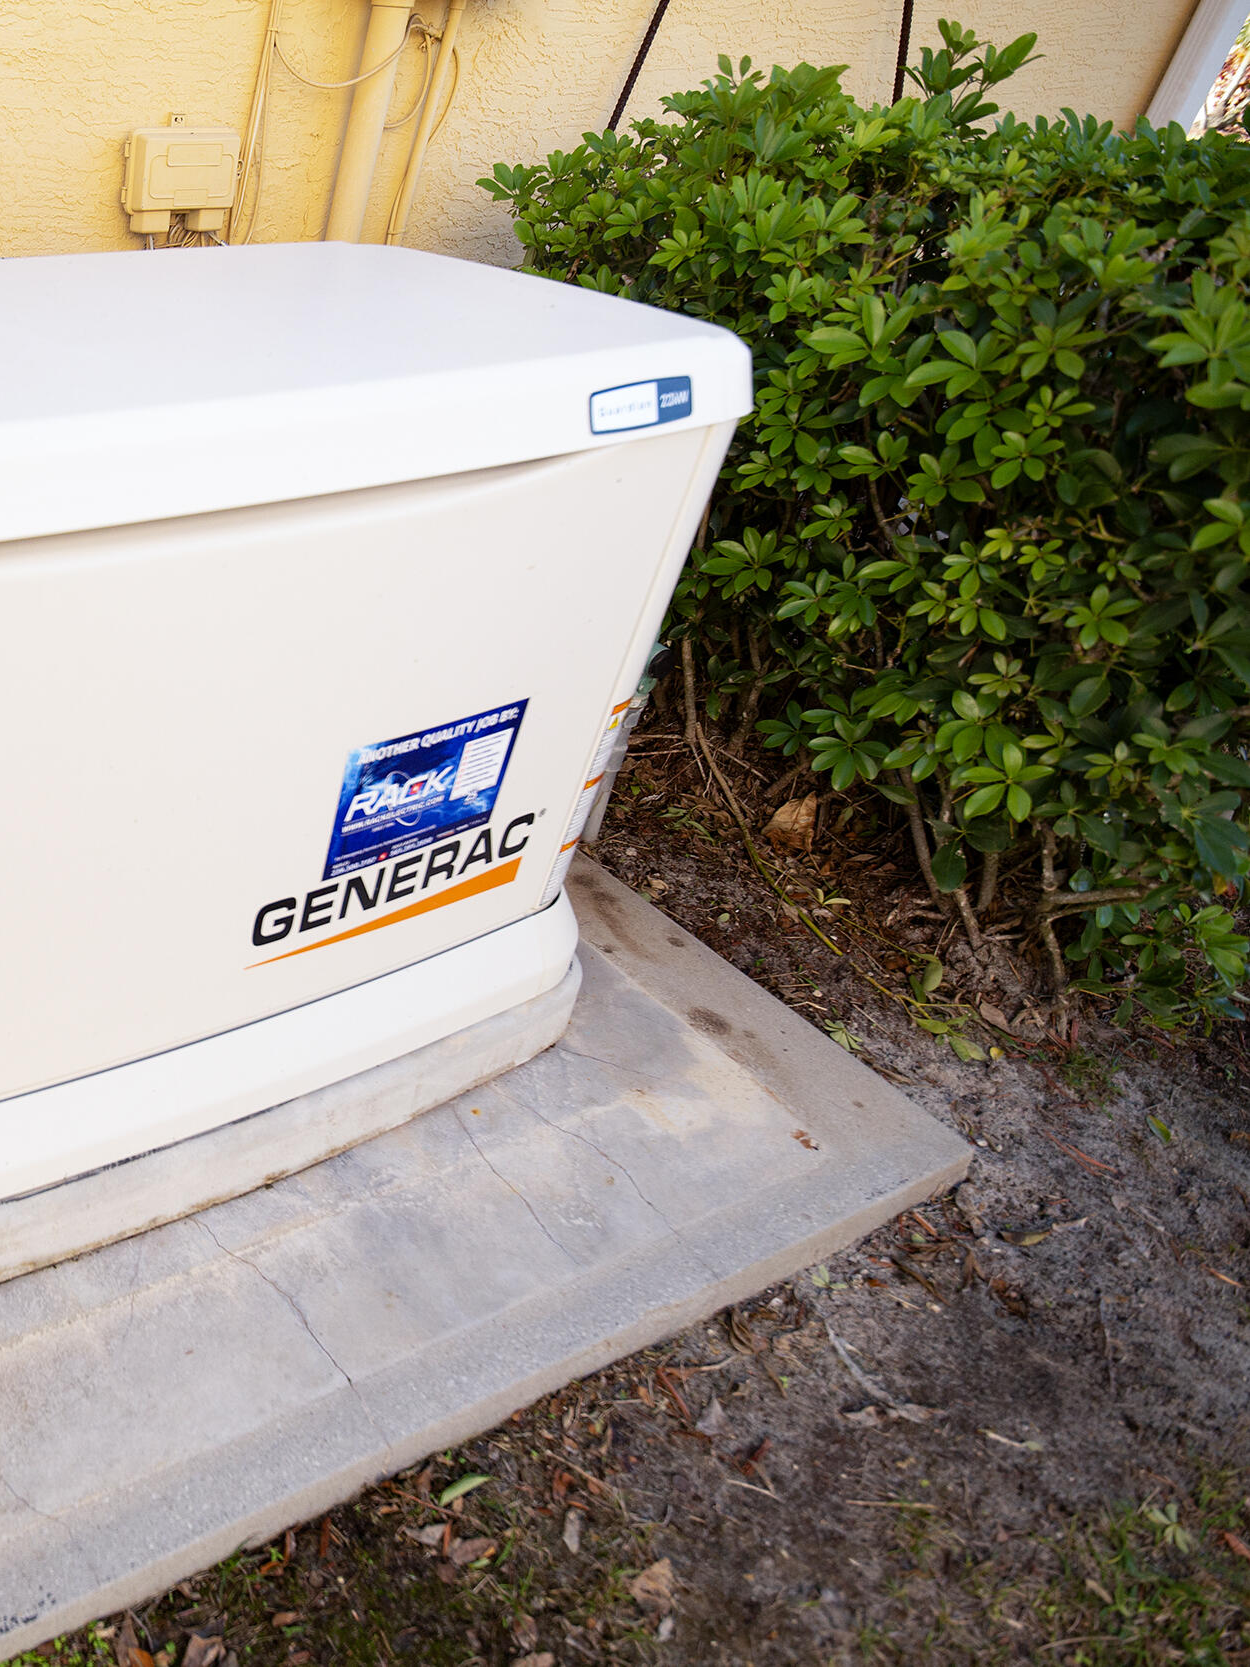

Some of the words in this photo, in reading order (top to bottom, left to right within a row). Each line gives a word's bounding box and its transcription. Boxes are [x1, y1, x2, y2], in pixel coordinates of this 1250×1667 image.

[357, 738, 420, 765] ANOTHER
[420, 721, 476, 748] QUALITY
[474, 713, 499, 733] JOB
[344, 765, 455, 823] RACK
[252, 812, 535, 947] GENERAC
